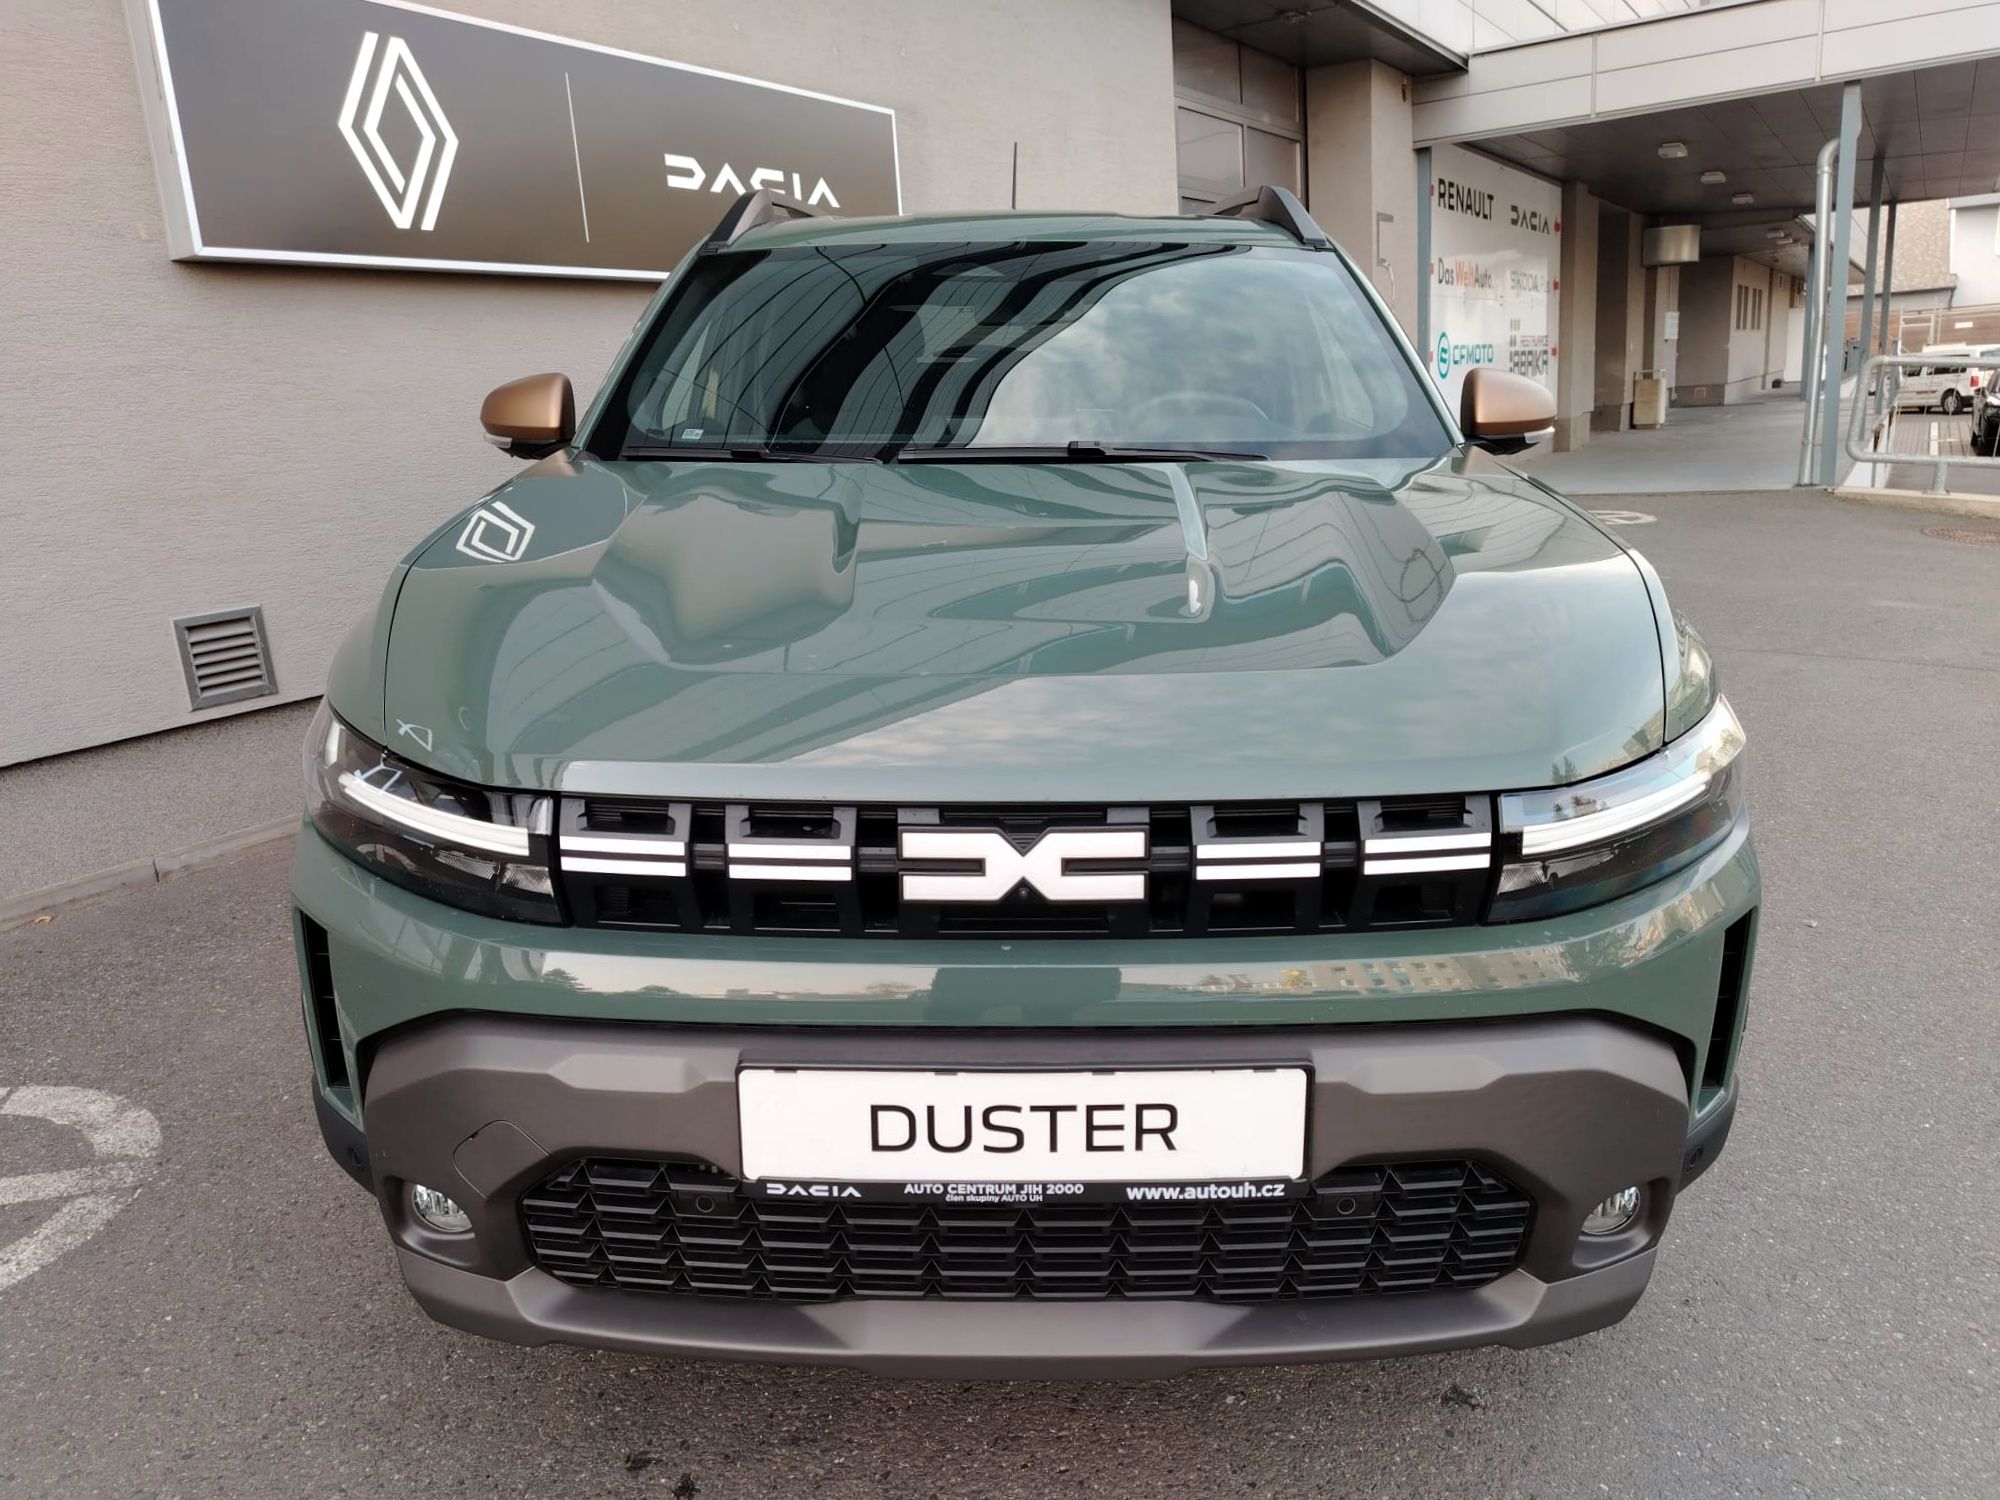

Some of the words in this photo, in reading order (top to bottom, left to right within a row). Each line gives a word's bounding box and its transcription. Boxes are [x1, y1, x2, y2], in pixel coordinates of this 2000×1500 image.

[664, 153, 841, 208] DACIA
[1438, 177, 1494, 221] RENAULT
[1511, 204, 1550, 235] DACIA
[1438, 257, 1454, 286] Das
[1453, 344, 1494, 365] CFMOTO
[870, 1103, 1179, 1153] DUSTER
[766, 1183, 862, 1197] DACIA
[904, 1184, 943, 1194] AUTO
[947, 1184, 1016, 1194] CENTRUM
[1020, 1184, 1042, 1194] JIH
[1046, 1184, 1084, 1194] 2000
[966, 1193, 1000, 1203] skupiny
[1001, 1194, 1027, 1202] AUTO
[1126, 1182, 1285, 1200] www.autouh.cz
